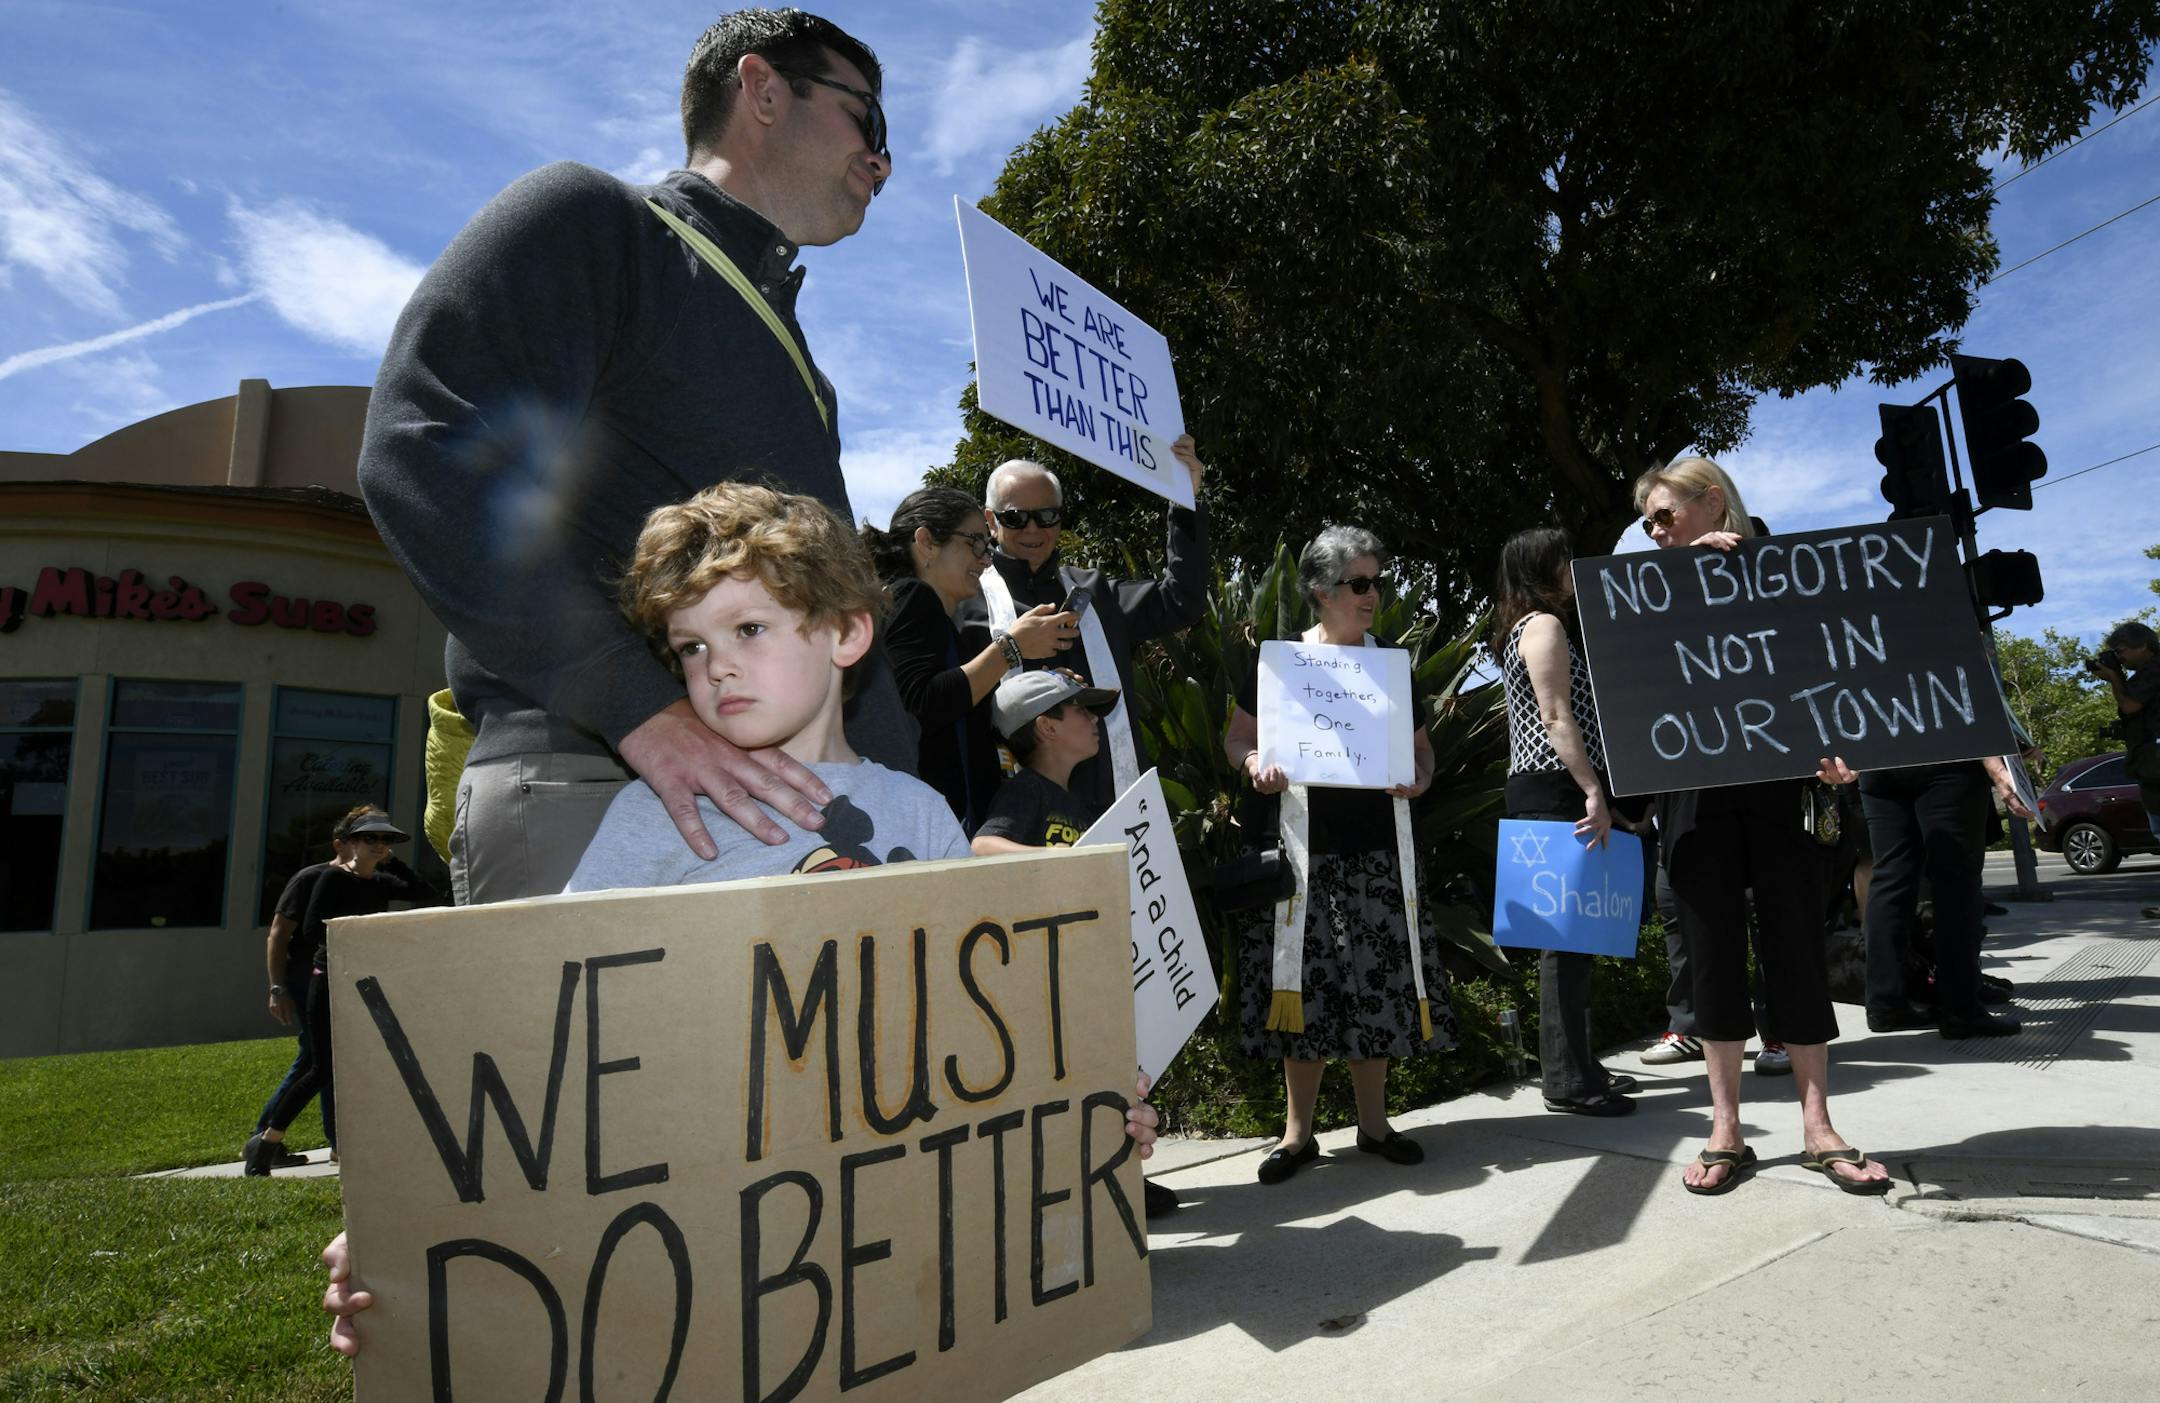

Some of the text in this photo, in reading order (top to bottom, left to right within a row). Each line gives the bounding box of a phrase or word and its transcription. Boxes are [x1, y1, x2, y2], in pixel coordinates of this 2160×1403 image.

[1029, 267, 1132, 361] WE ARE
[1020, 307, 1149, 425] BETTER
[1023, 371, 1157, 471] THAN THIS
[30, 566, 218, 622] Mike's
[1600, 527, 1934, 620] NO BIGOTRY
[1294, 652, 1361, 673] Standing
[1674, 614, 1887, 684] NOT IN
[1303, 682, 1376, 703] together,
[1314, 713, 1355, 731] One
[1650, 665, 1976, 761] OUR TOWN
[1298, 742, 1366, 766] Family.
[1148, 894, 1167, 924] a
[1532, 870, 1633, 921] Shalom
[355, 910, 1098, 1204] WE MUST
[426, 1091, 1148, 1403] DO BETTER
